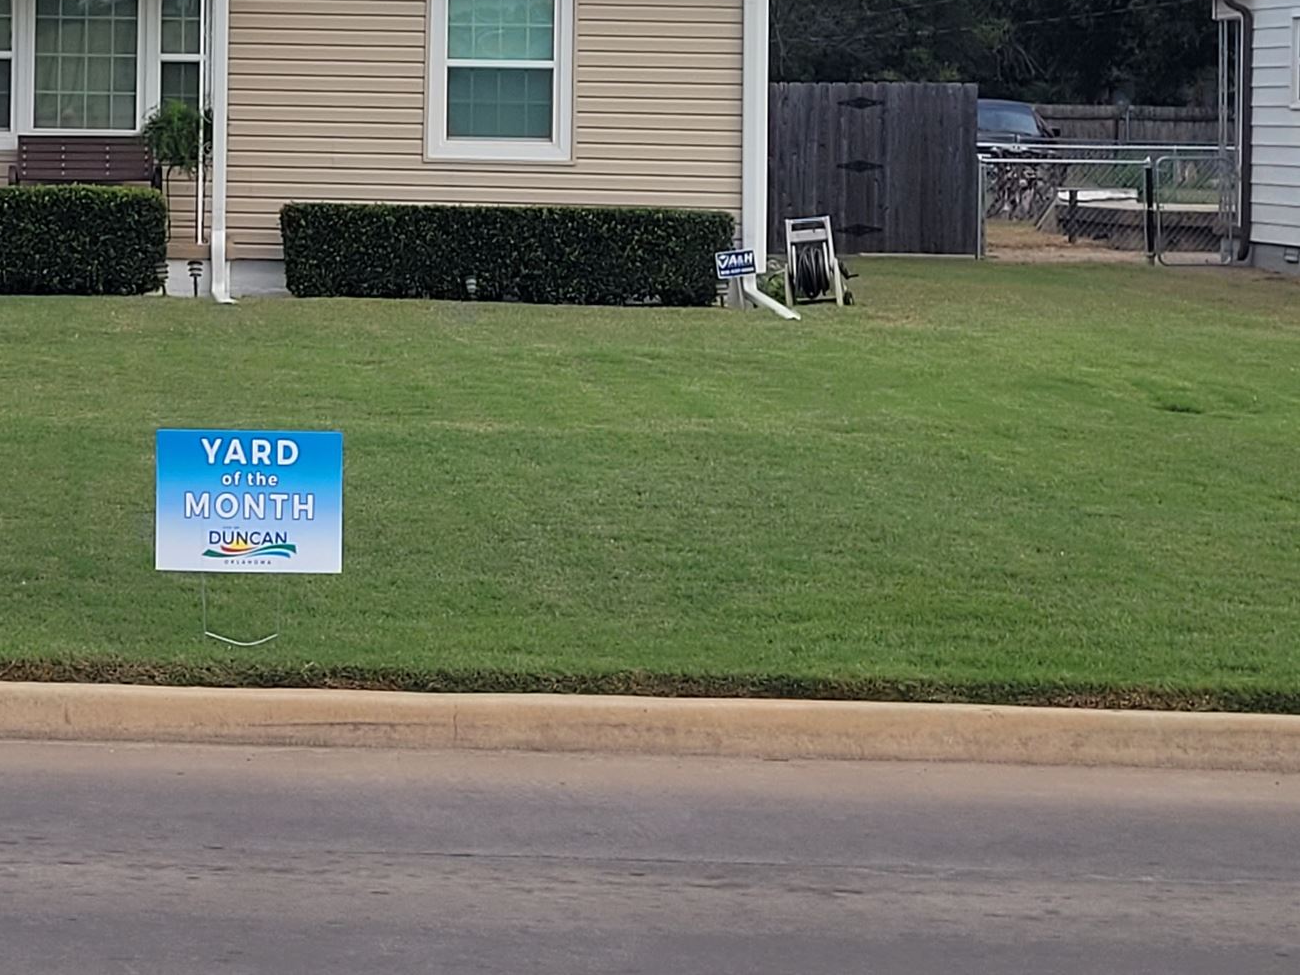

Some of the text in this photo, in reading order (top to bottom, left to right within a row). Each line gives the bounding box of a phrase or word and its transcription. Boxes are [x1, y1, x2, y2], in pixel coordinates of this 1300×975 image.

[201, 438, 300, 466] YARD
[222, 471, 278, 486] of the
[184, 492, 315, 520] MONTH
[208, 530, 288, 546] DUNCAN
